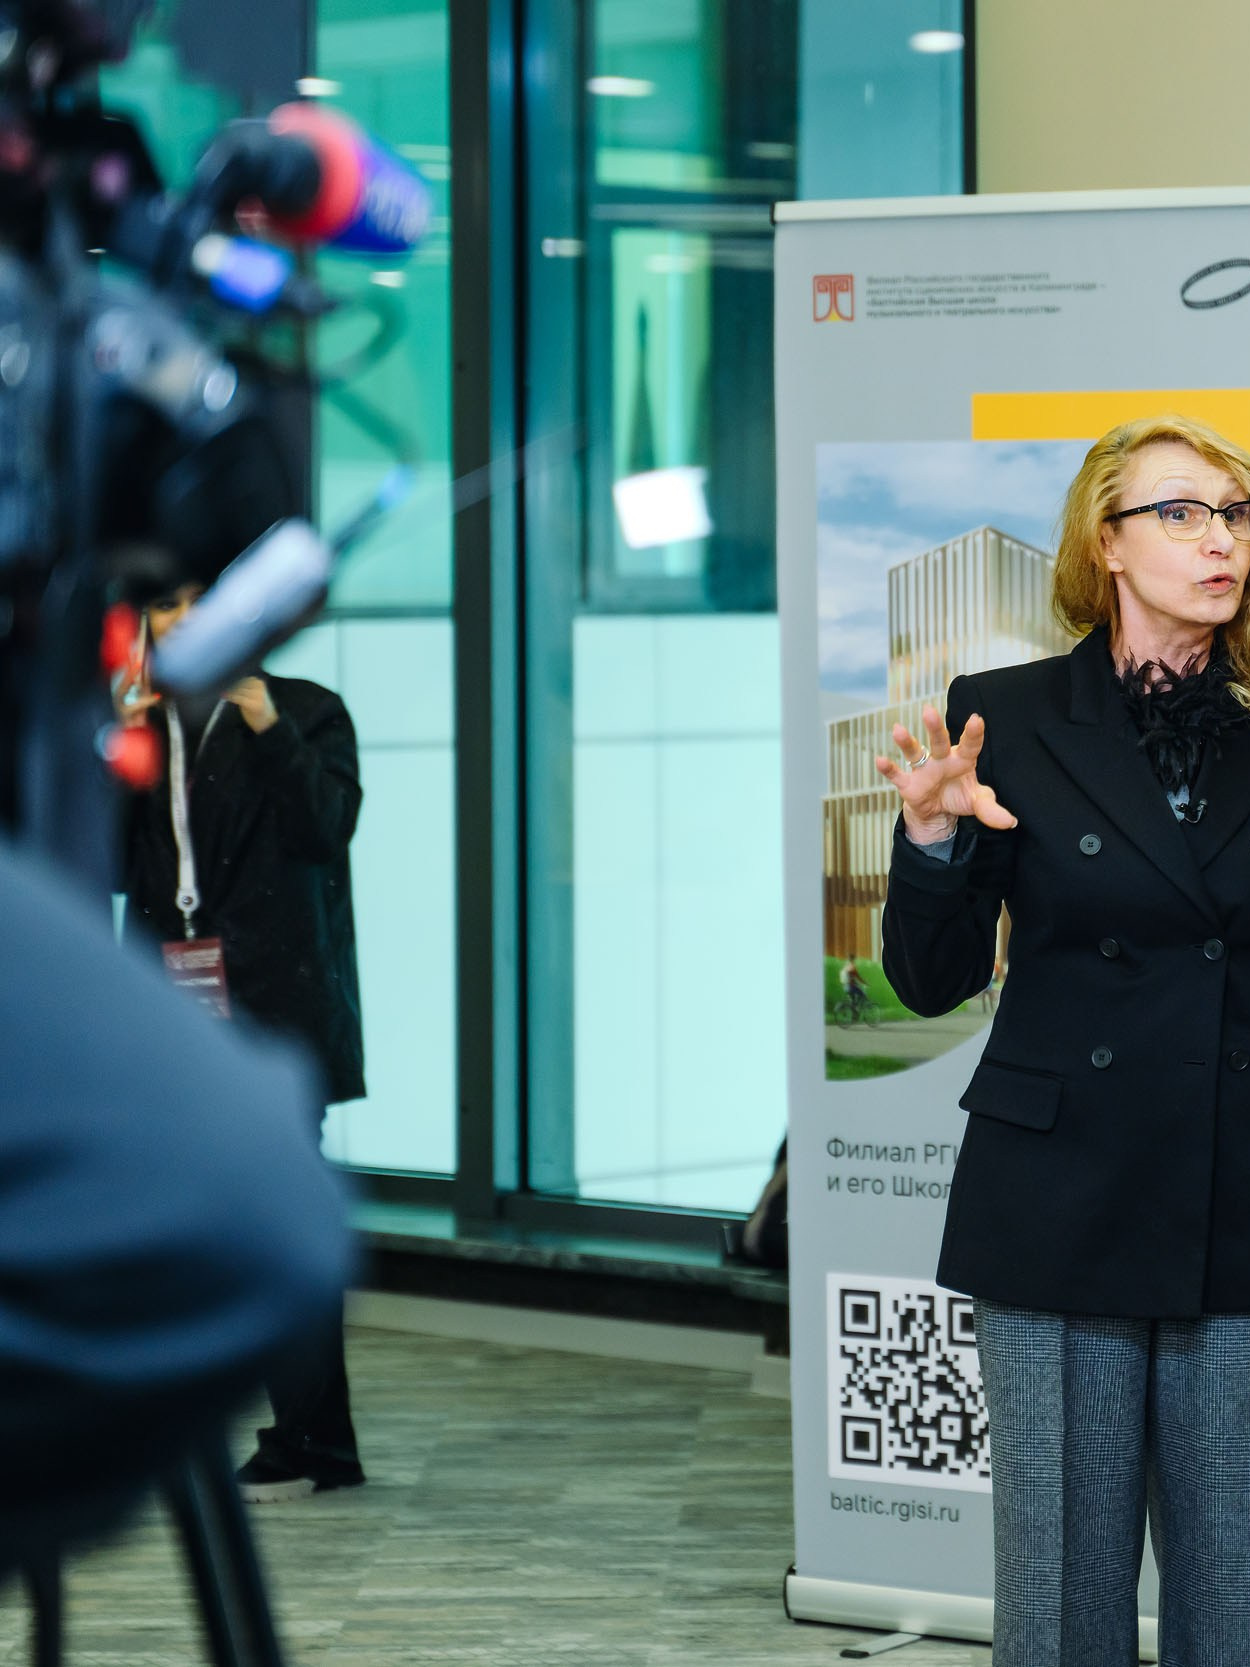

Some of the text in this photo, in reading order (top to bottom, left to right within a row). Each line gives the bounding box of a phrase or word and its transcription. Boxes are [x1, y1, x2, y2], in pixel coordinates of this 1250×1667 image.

[826, 1138, 915, 1162] Филиал
[827, 1176, 840, 1192] и
[847, 1177, 885, 1195] его
[831, 1491, 959, 1522] baltic.rgisi.ru
